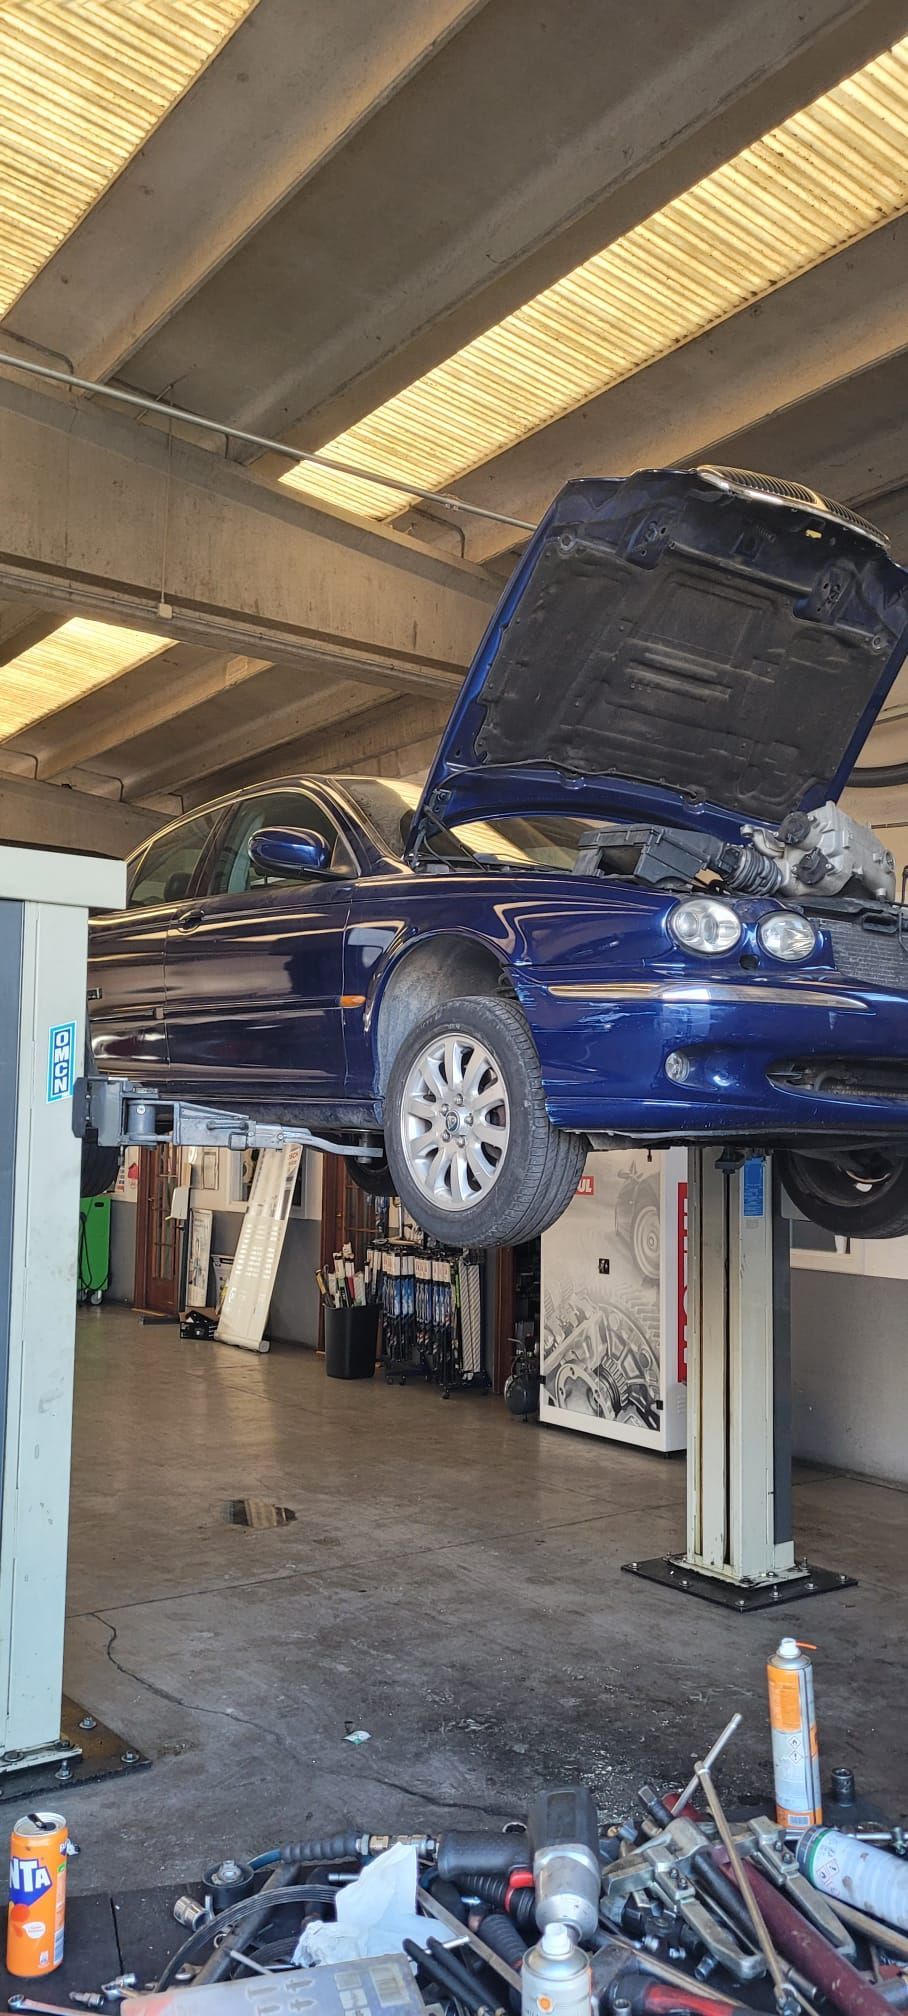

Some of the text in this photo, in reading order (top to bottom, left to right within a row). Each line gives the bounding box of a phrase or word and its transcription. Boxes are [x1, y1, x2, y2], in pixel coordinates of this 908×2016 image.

[54, 1031, 69, 1094] OMCN
[576, 1178, 592, 1193] UL
[9, 1856, 51, 1893] NTA
